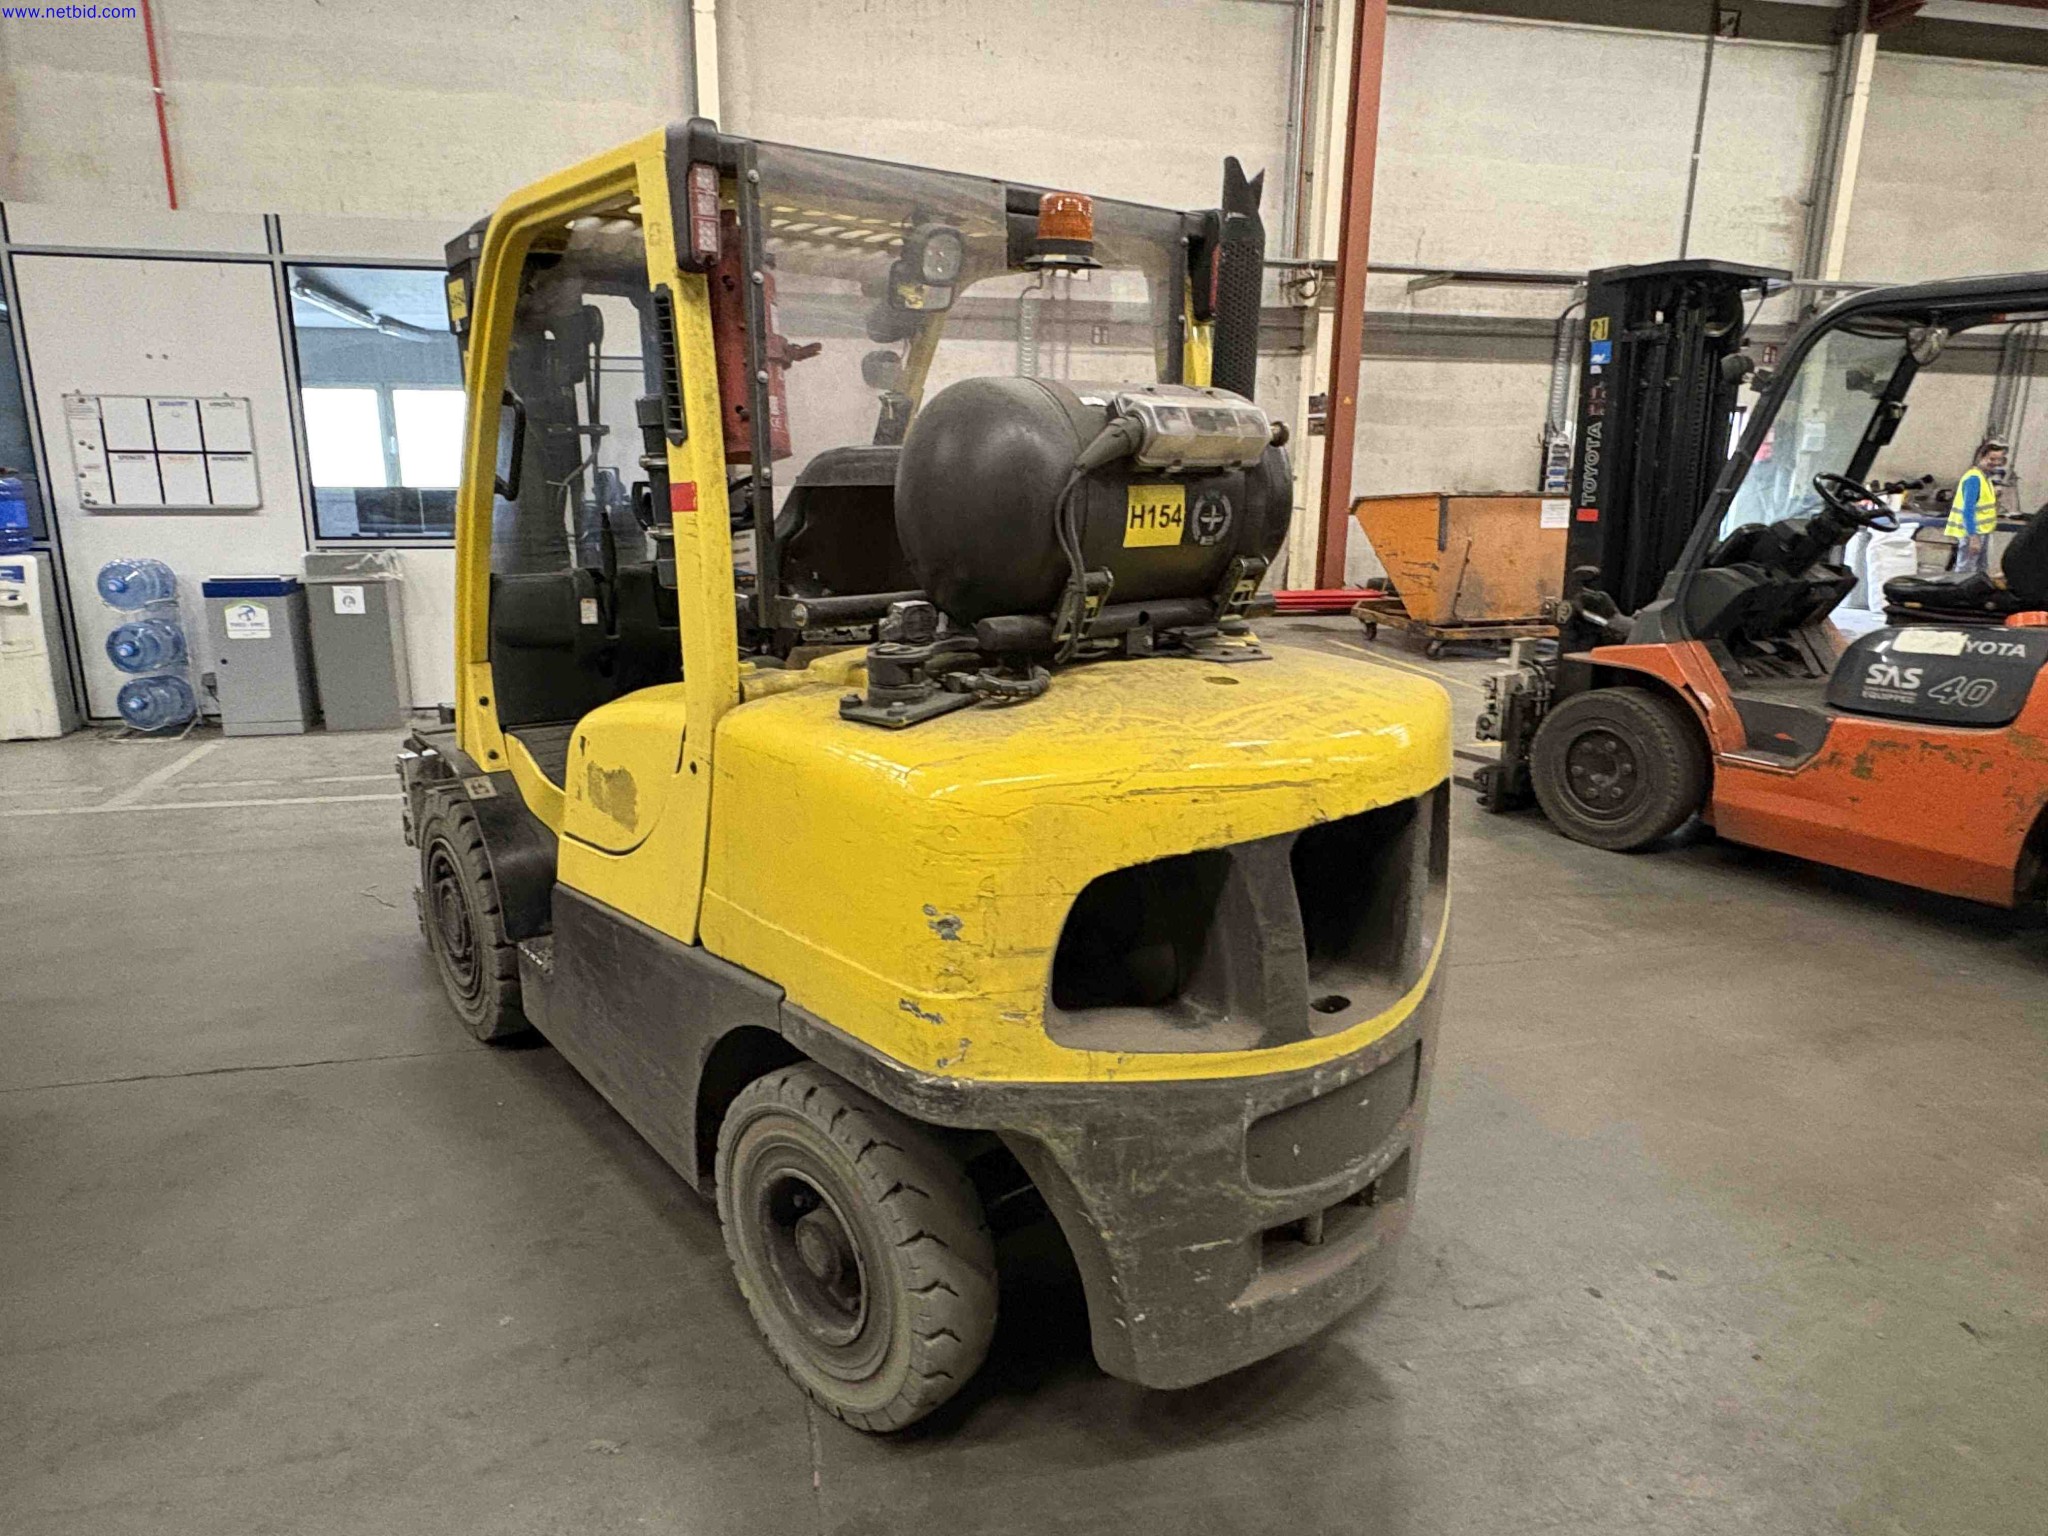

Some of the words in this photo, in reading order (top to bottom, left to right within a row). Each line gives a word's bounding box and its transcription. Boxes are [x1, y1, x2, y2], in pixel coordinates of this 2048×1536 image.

[1591, 320, 1607, 340] 21
[1581, 421, 1603, 506] TOYOTA
[1129, 503, 1183, 529] H154
[1965, 641, 2027, 658] YOTA
[1865, 663, 1924, 690] SAS
[1927, 675, 1998, 708] 40
